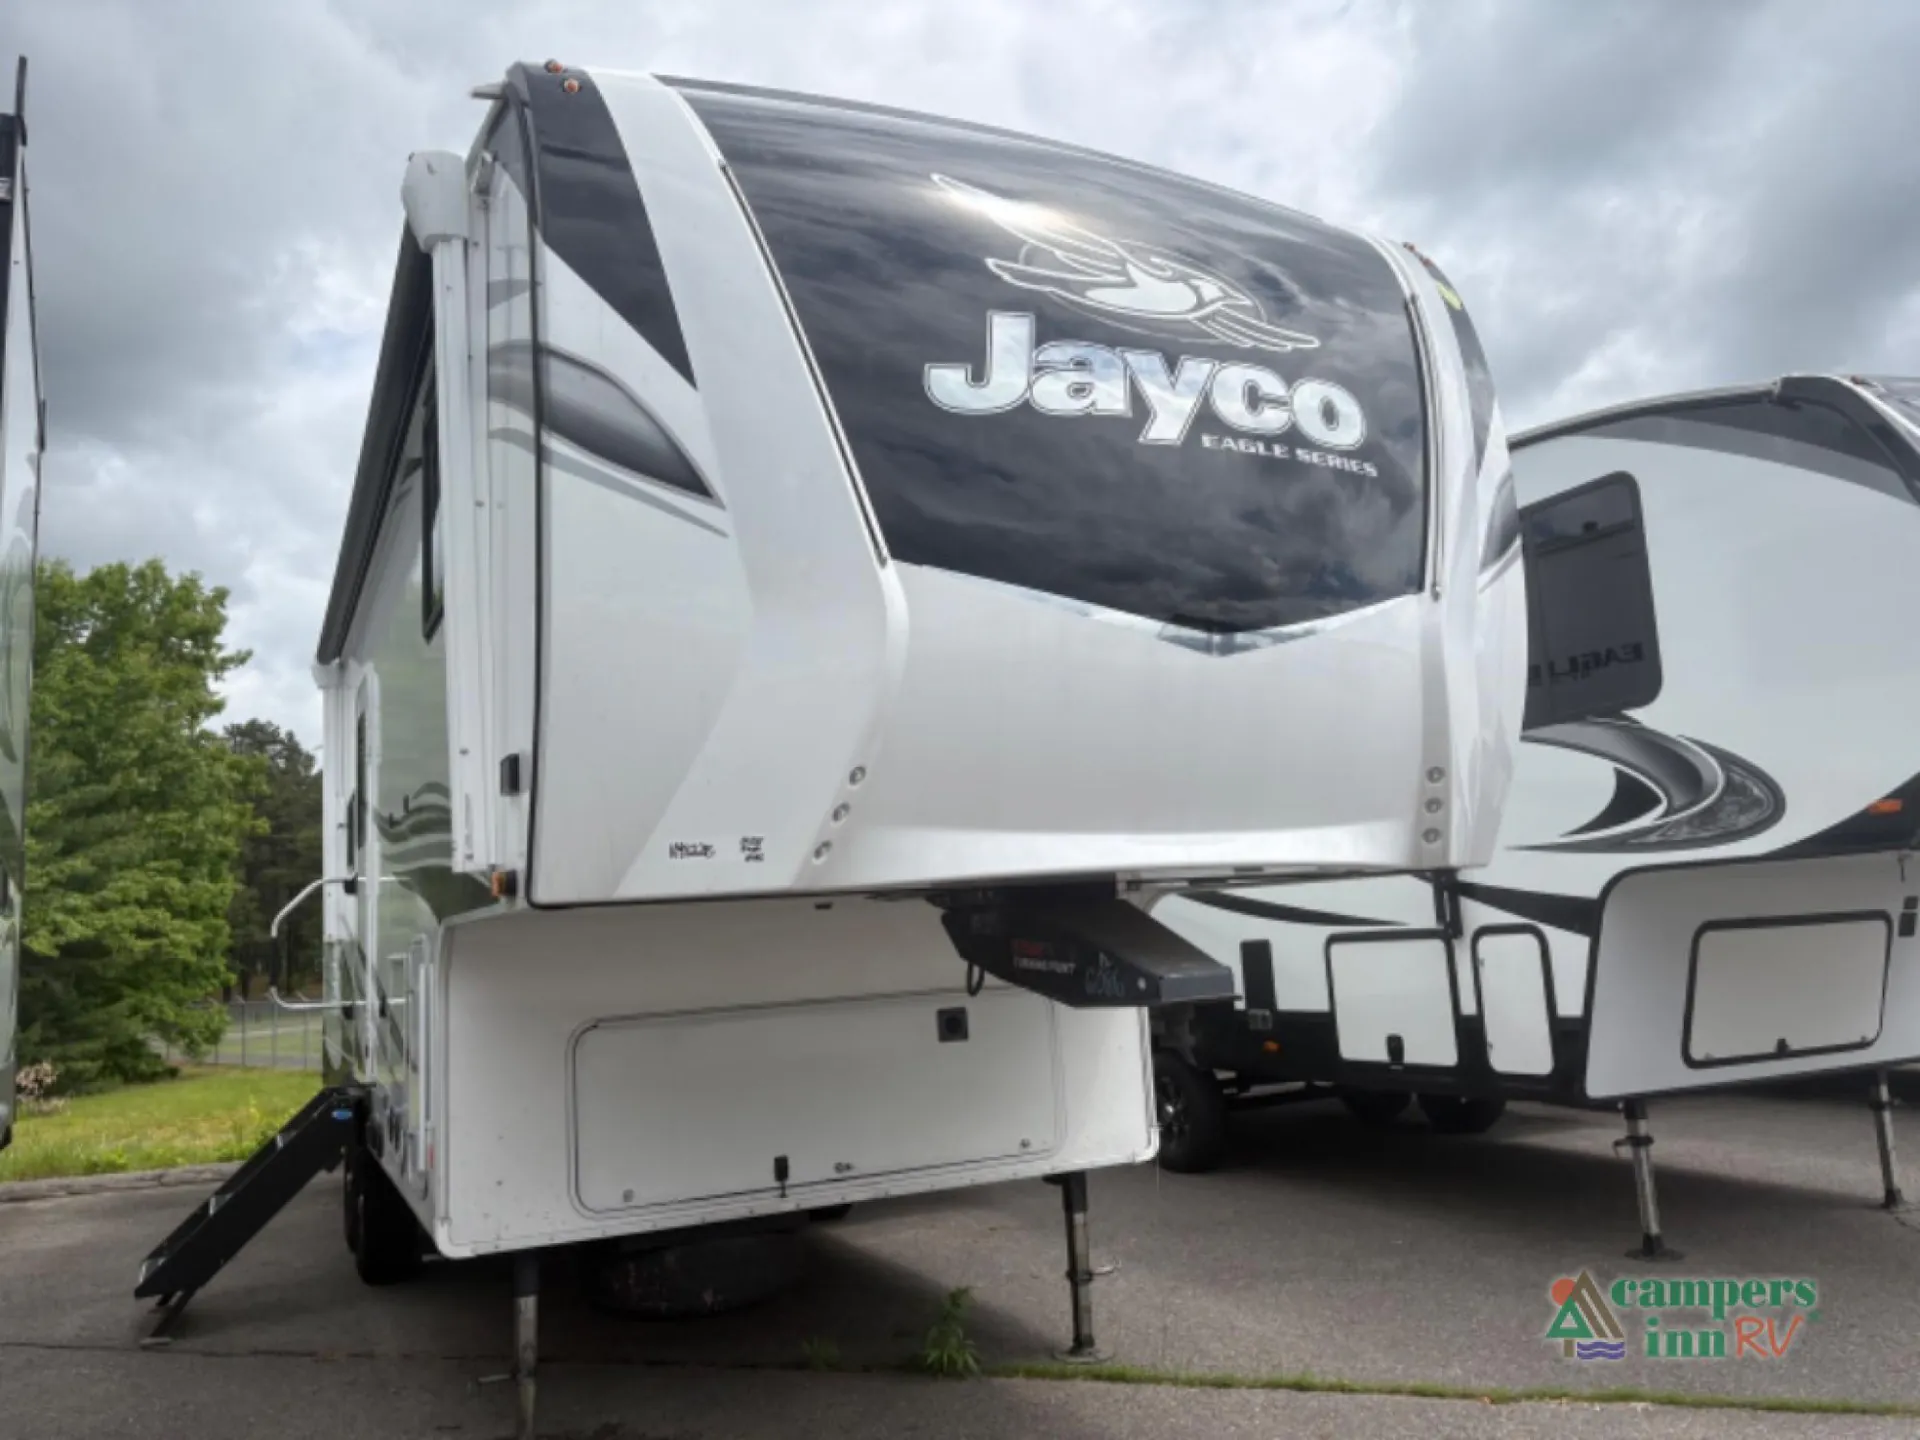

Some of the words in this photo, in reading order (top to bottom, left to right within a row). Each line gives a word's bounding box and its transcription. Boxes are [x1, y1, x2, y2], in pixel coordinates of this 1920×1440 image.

[923, 309, 1367, 450] Jayco
[1201, 433, 1290, 459] EAGLE
[1296, 447, 1378, 478] SERIES
